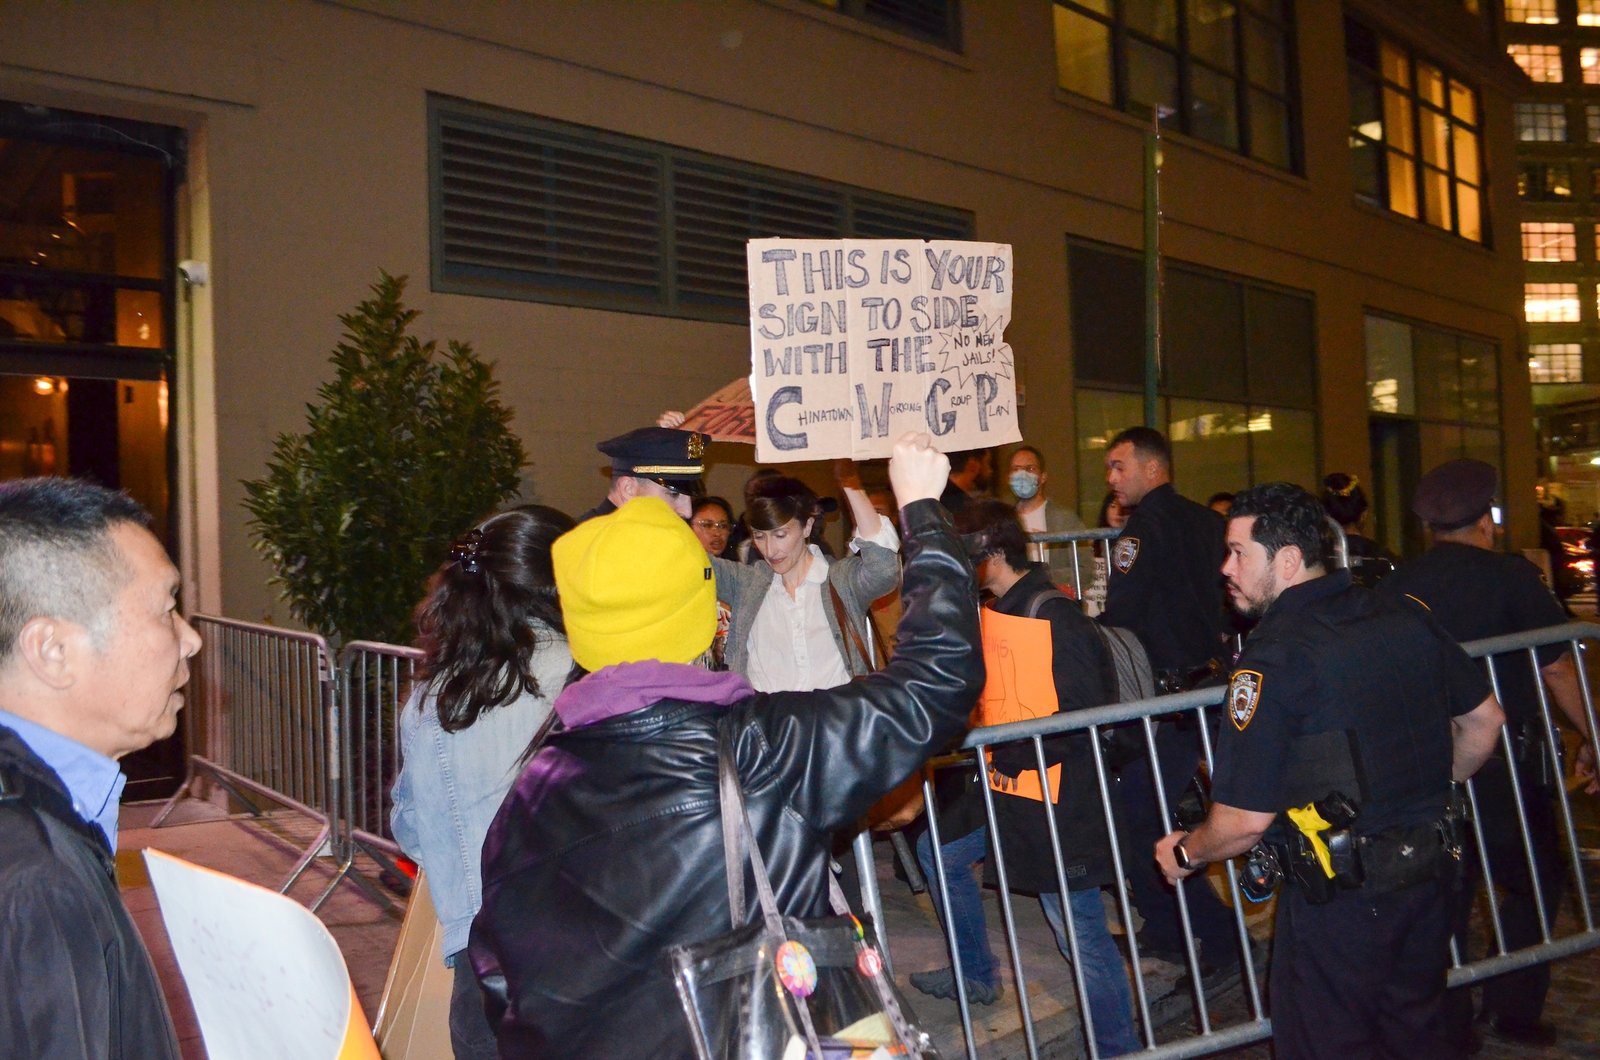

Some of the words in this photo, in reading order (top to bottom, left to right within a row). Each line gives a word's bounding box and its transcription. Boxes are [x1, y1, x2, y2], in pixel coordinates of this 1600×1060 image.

[761, 248, 871, 296] THIS
[880, 249, 912, 285] IS
[925, 248, 1006, 294] YOUR
[758, 299, 848, 340] SIGN
[861, 297, 902, 332] TO
[910, 295, 980, 333] SIDE
[763, 341, 848, 378] WITH
[867, 336, 936, 375] THE
[953, 332, 971, 349] NO
[976, 331, 996, 348] NEW
[962, 348, 997, 367] JAILS!
